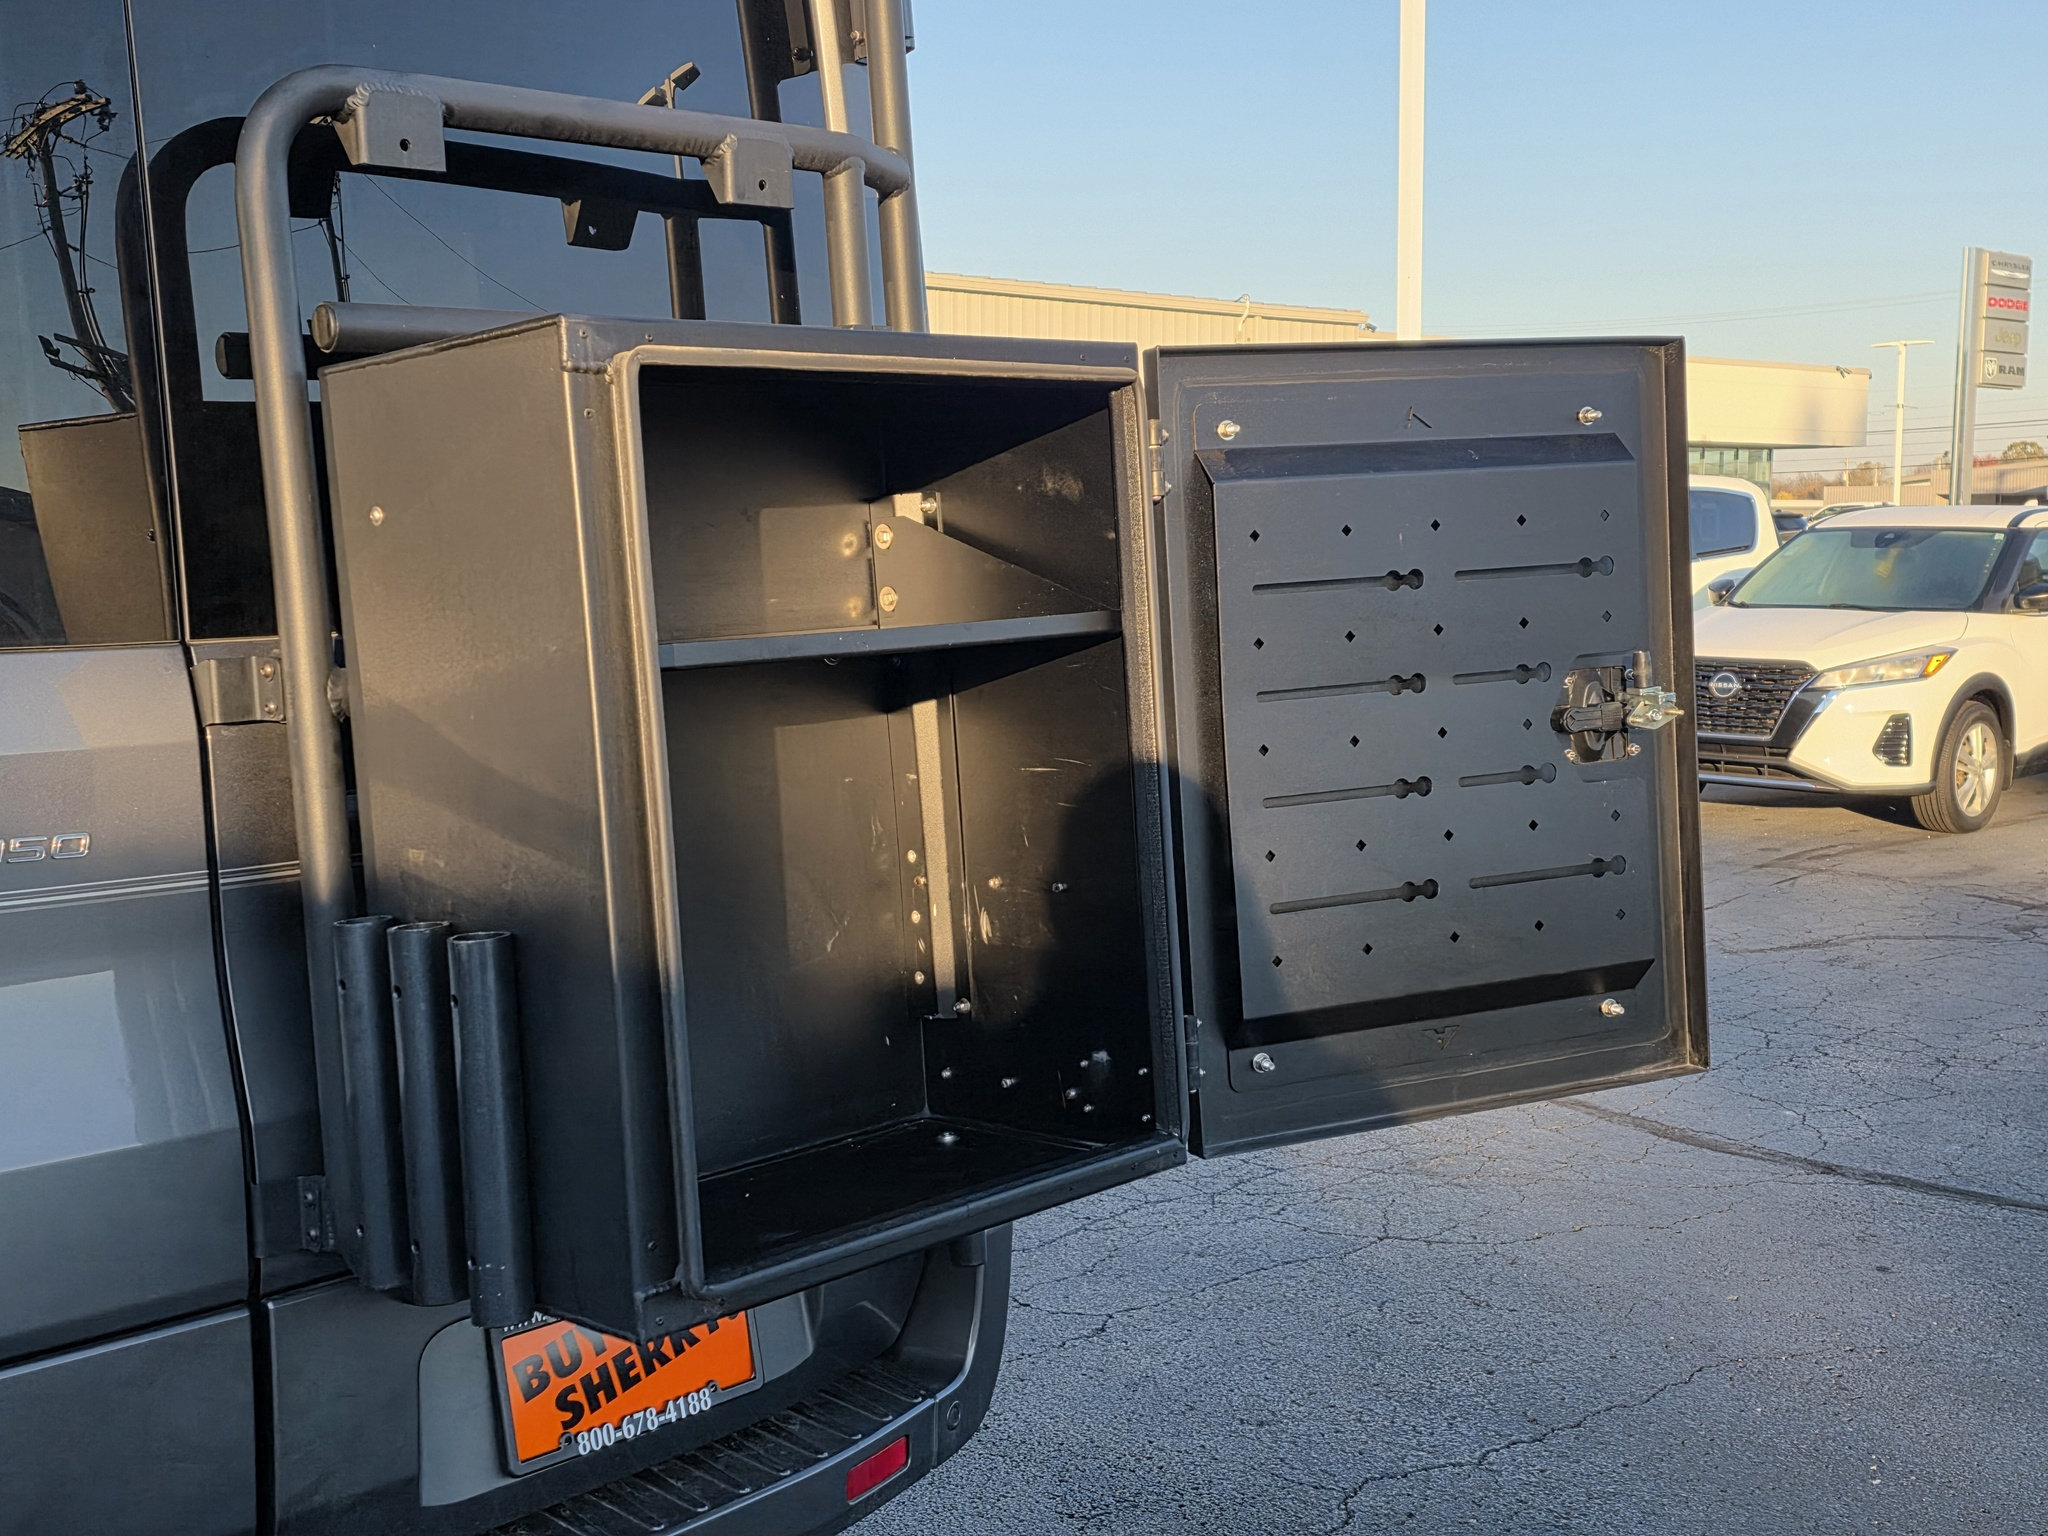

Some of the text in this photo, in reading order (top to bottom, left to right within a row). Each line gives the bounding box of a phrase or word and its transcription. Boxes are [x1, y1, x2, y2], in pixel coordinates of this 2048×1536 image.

[1988, 297, 2029, 312] DODGE
[1995, 327, 2022, 348] Jeep
[1998, 364, 2026, 377] RAM
[577, 1387, 712, 1456] 800-678-4188
